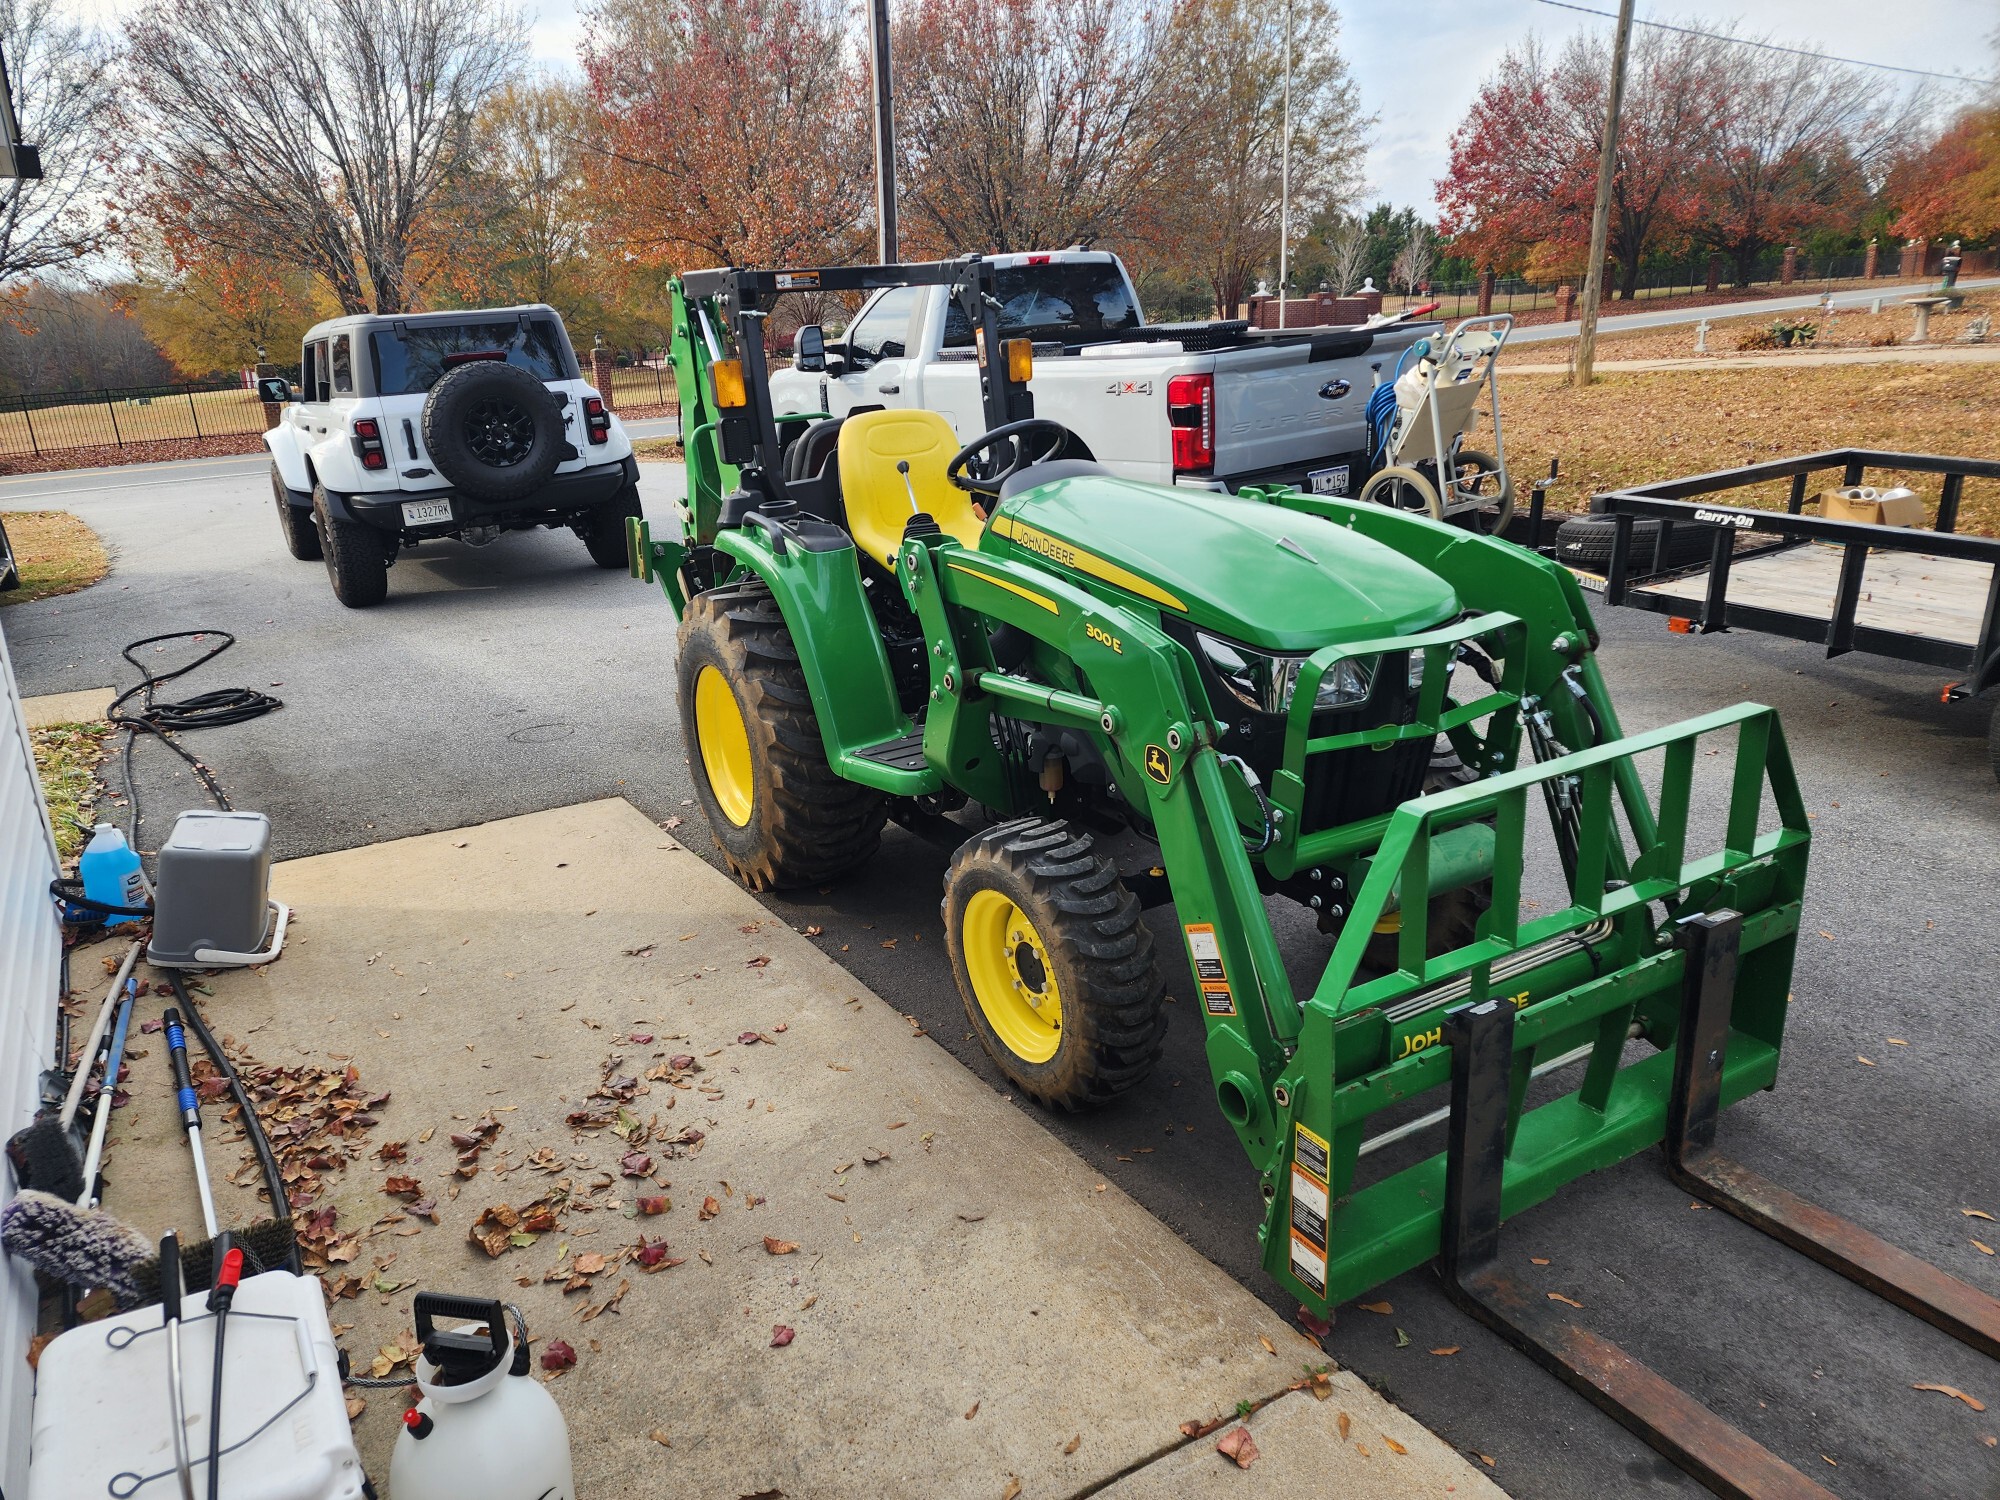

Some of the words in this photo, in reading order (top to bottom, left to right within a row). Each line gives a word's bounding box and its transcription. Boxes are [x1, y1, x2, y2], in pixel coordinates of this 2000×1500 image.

[1231, 406, 1344, 434] SUPER
[1333, 473, 1347, 489] 159
[416, 504, 450, 519] 1327RK
[1694, 509, 1755, 527] Carry-On
[1016, 528, 1042, 553] JOHN
[1042, 537, 1075, 568] DEERE
[1398, 1026, 1442, 1059] JOH
